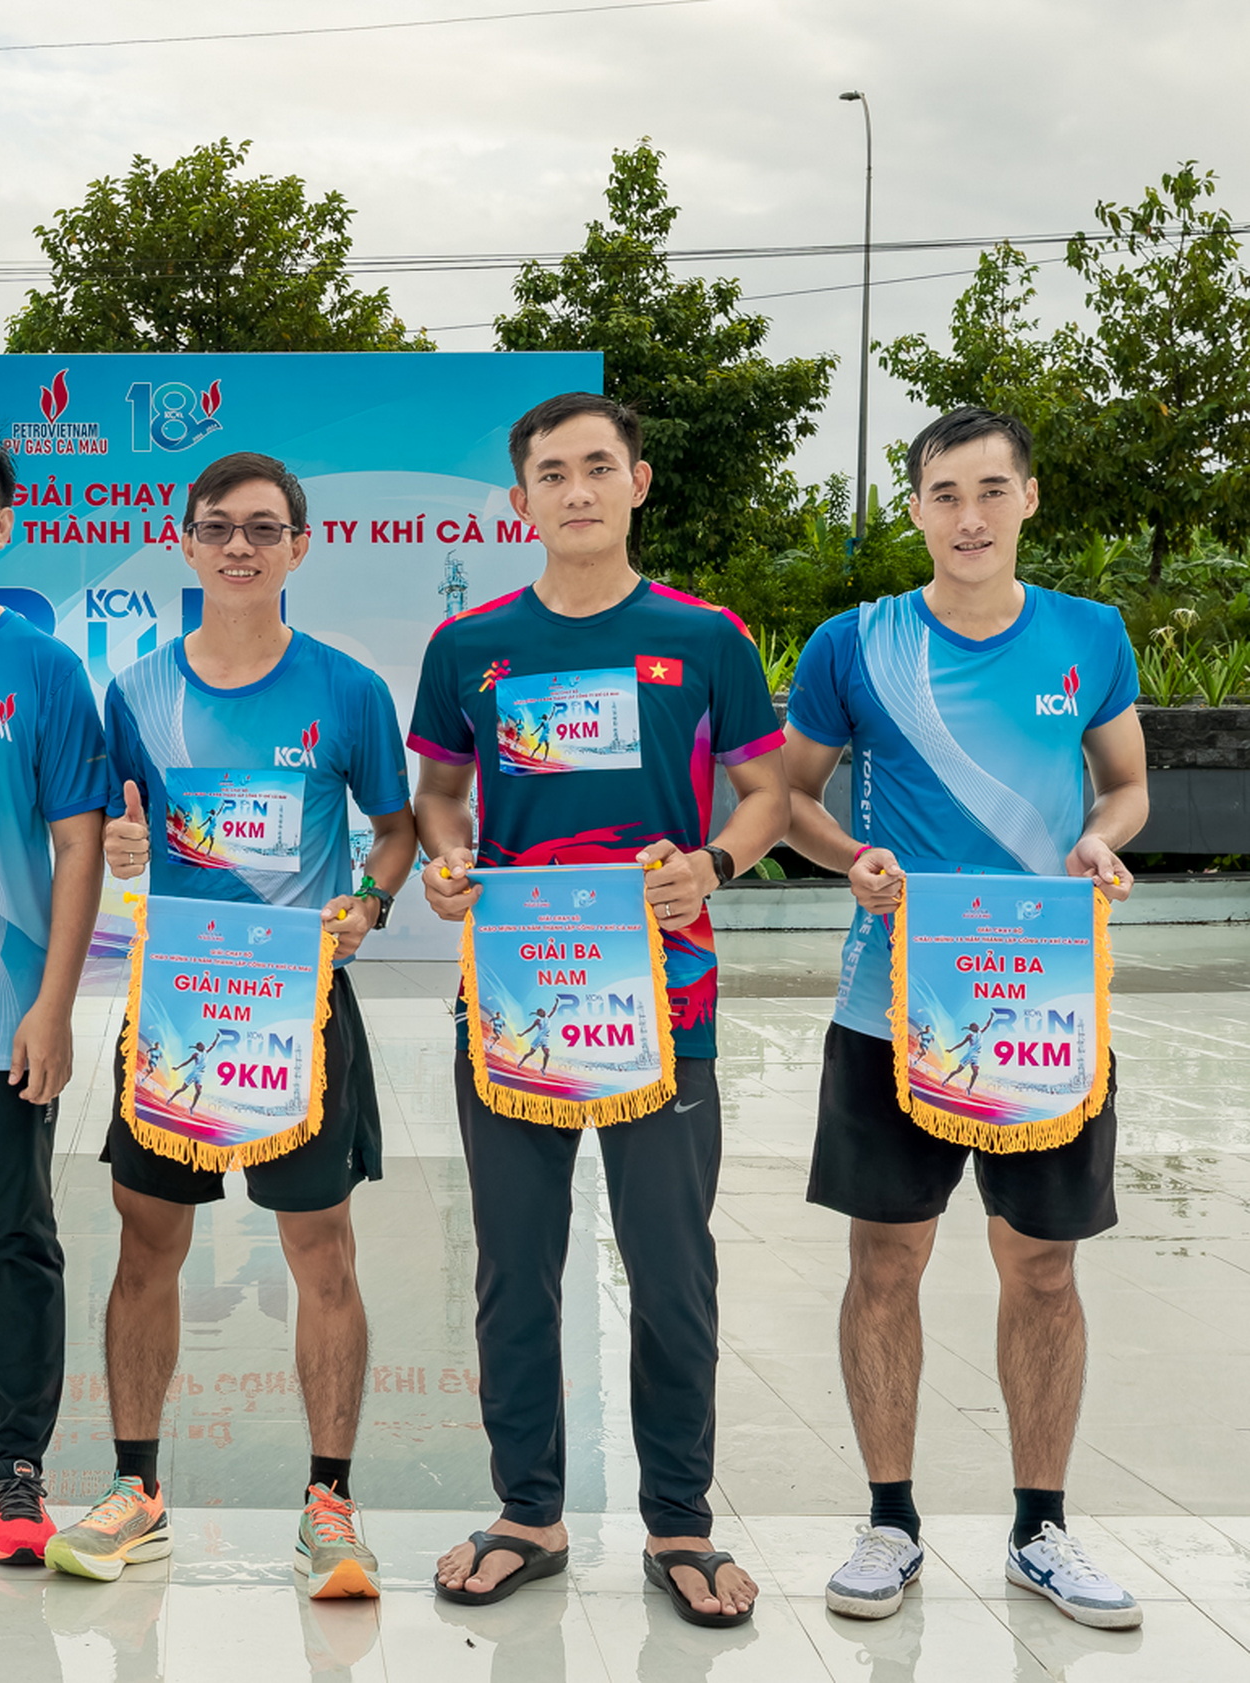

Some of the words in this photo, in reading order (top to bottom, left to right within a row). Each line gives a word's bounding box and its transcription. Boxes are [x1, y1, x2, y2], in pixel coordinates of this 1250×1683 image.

[125, 382, 197, 452] 18
[12, 423, 98, 438] PETROVIETNAM
[25, 438, 53, 454] GAS
[78, 438, 108, 454] MAU
[12, 475, 72, 506] GIẢI
[84, 483, 176, 513] CHẠY
[23, 514, 130, 544] THÀNH
[143, 515, 181, 551] LẬ
[322, 520, 359, 544] TY
[370, 513, 426, 544] KHÍ
[436, 513, 485, 544] CÀ
[496, 520, 541, 544] MA
[86, 589, 157, 619] KCM
[1036, 694, 1079, 716] KCM
[556, 721, 599, 740] 9KM
[274, 746, 317, 769] KCM
[222, 821, 265, 839] 9KM
[519, 938, 565, 960] GIẢI
[574, 943, 602, 960] BA
[956, 951, 1005, 973] GIẢI
[1014, 957, 1044, 974] BA
[174, 971, 219, 994] GIẢI
[227, 975, 284, 998] NHẤT
[537, 969, 587, 986] NAM
[973, 982, 1026, 1000] NAM
[202, 1003, 251, 1021] NAM
[556, 993, 635, 1017] RUN
[991, 1008, 1074, 1035] RUN
[216, 1028, 294, 1059] RUN
[561, 1024, 635, 1047] 9KM
[993, 1041, 1071, 1066] 9KM
[217, 1061, 288, 1090] 9KM
